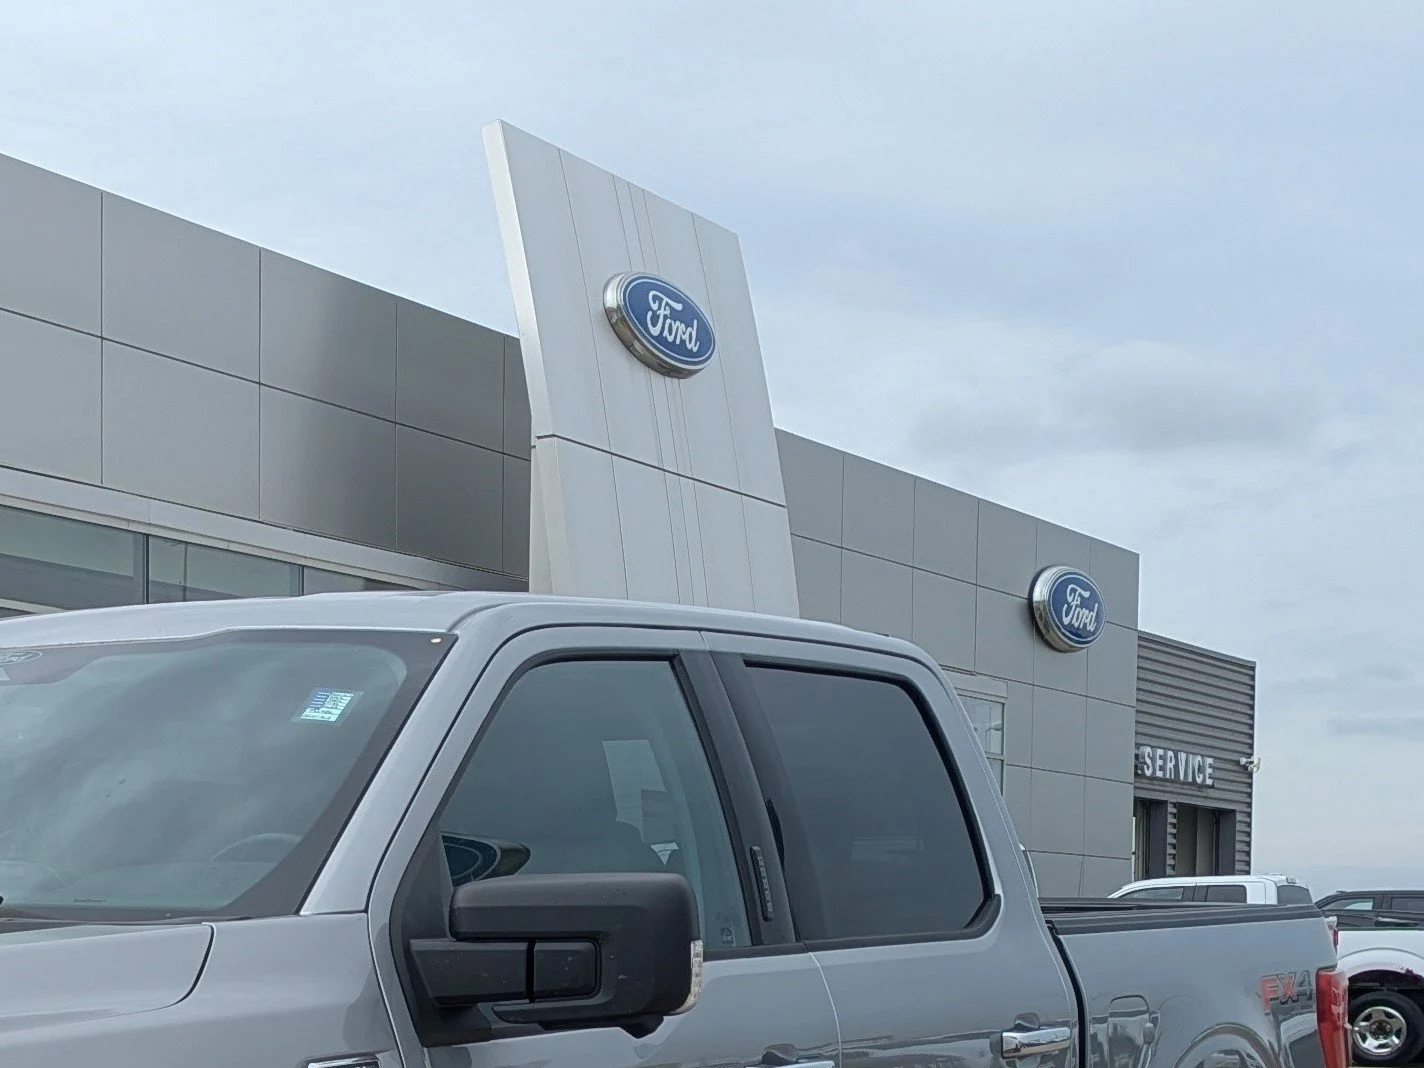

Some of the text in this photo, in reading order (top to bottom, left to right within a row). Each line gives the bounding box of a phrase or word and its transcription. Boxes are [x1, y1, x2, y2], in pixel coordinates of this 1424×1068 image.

[647, 290, 700, 352] Ford
[1062, 584, 1099, 632] Ford
[1143, 745, 1214, 785] SERVICE
[1260, 970, 1313, 1015] FX4
